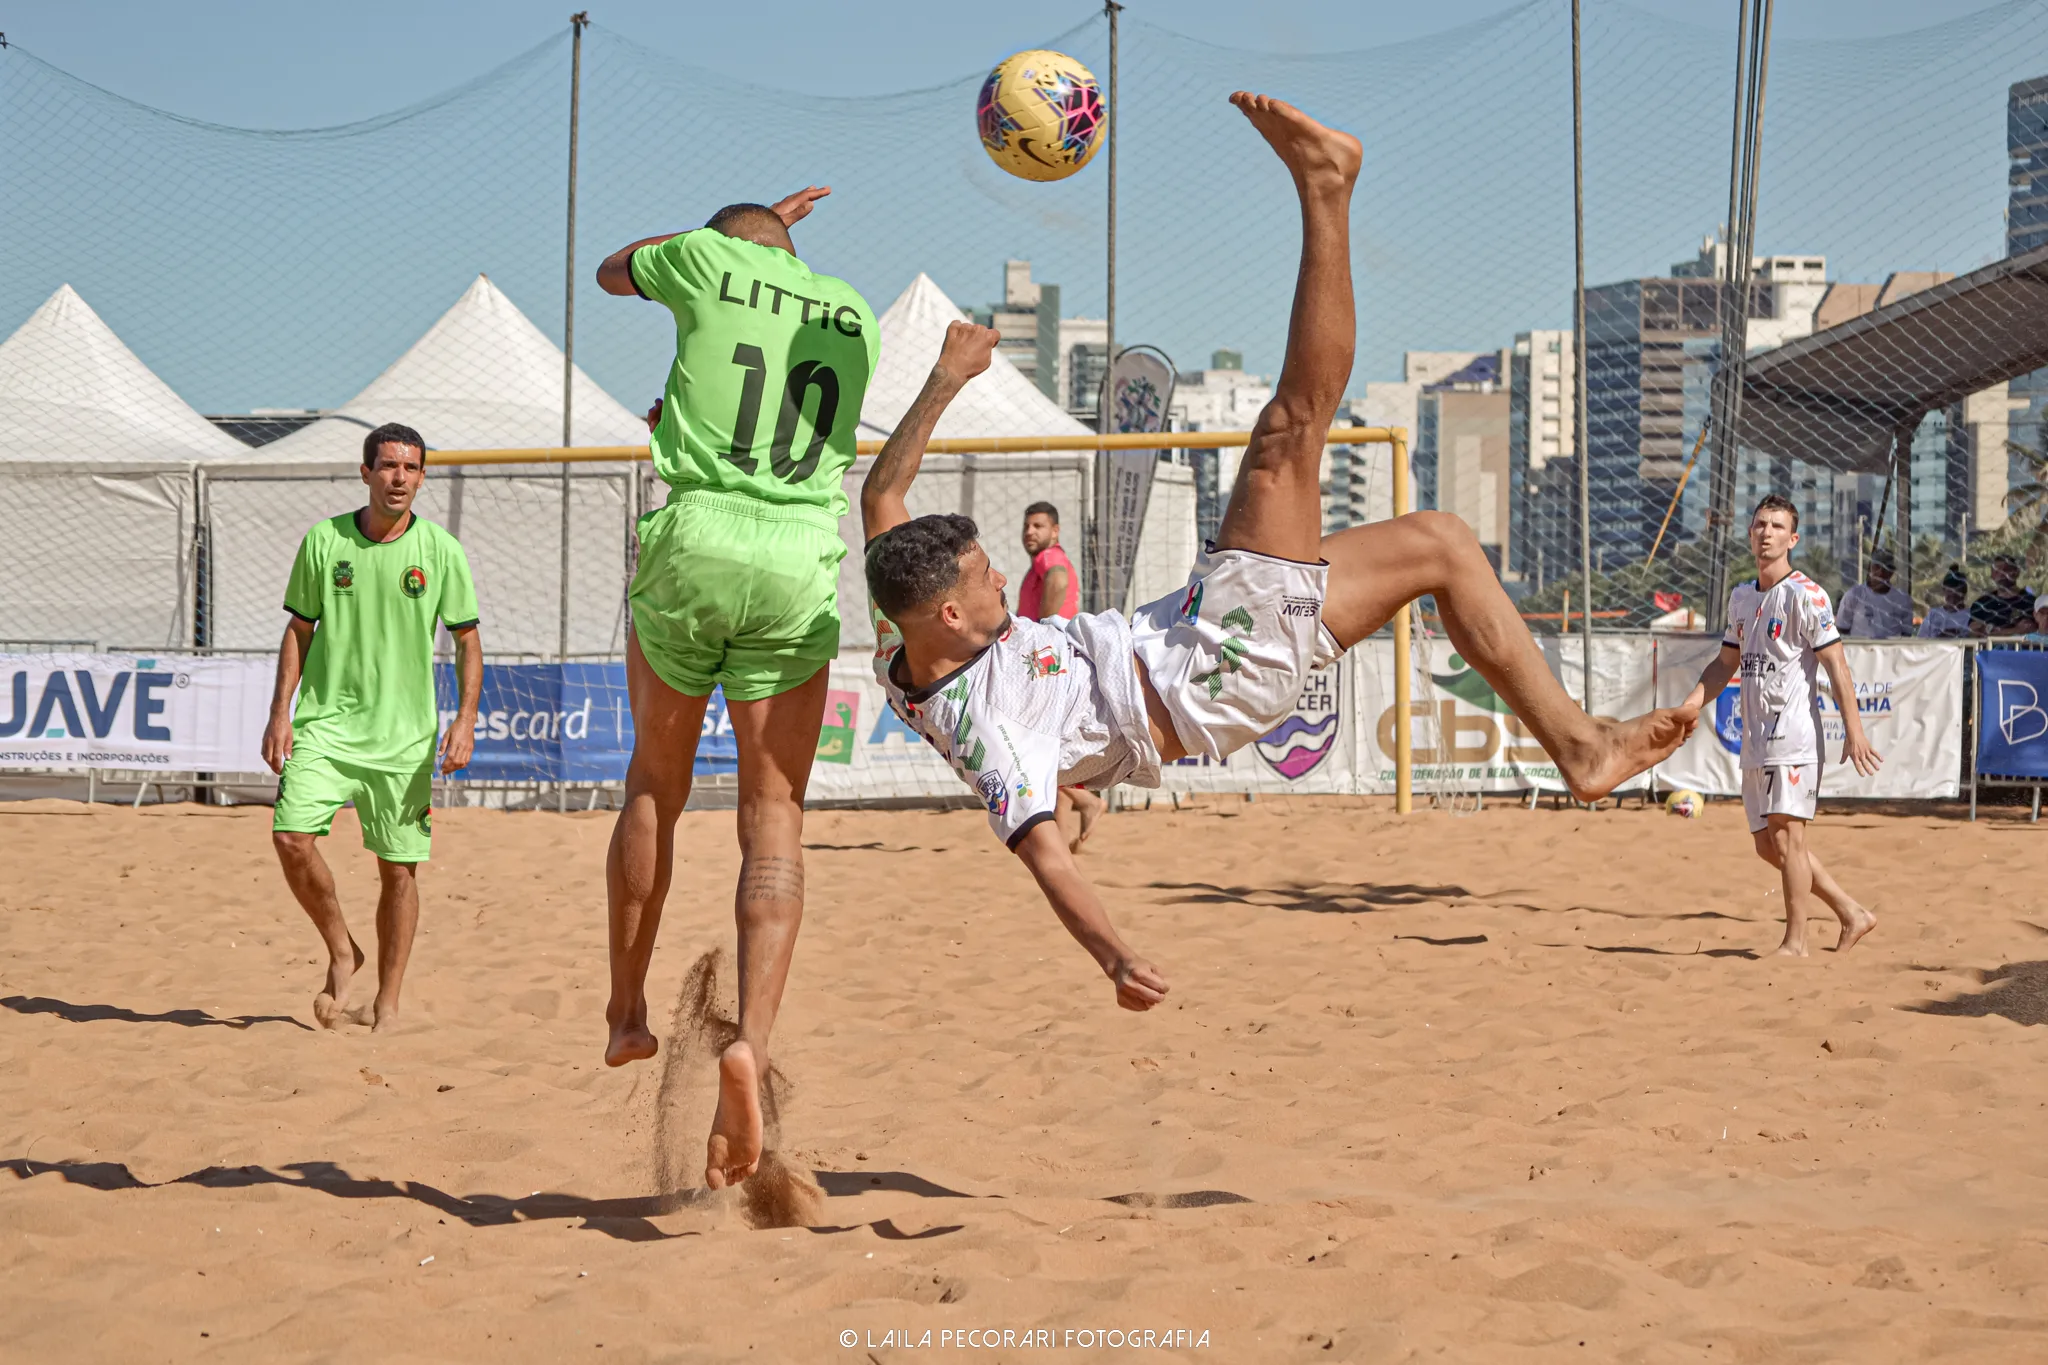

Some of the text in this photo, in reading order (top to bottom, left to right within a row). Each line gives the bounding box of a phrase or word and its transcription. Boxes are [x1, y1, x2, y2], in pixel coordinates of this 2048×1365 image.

[717, 342, 840, 485] 10
[1873, 682, 1893, 694] DE
[1771, 711, 1781, 734] 7
[66, 752, 73, 761] E
[77, 752, 170, 765] INCORPORAÇÕES
[1468, 767, 1482, 779] DE
[1764, 771, 1775, 795] 7
